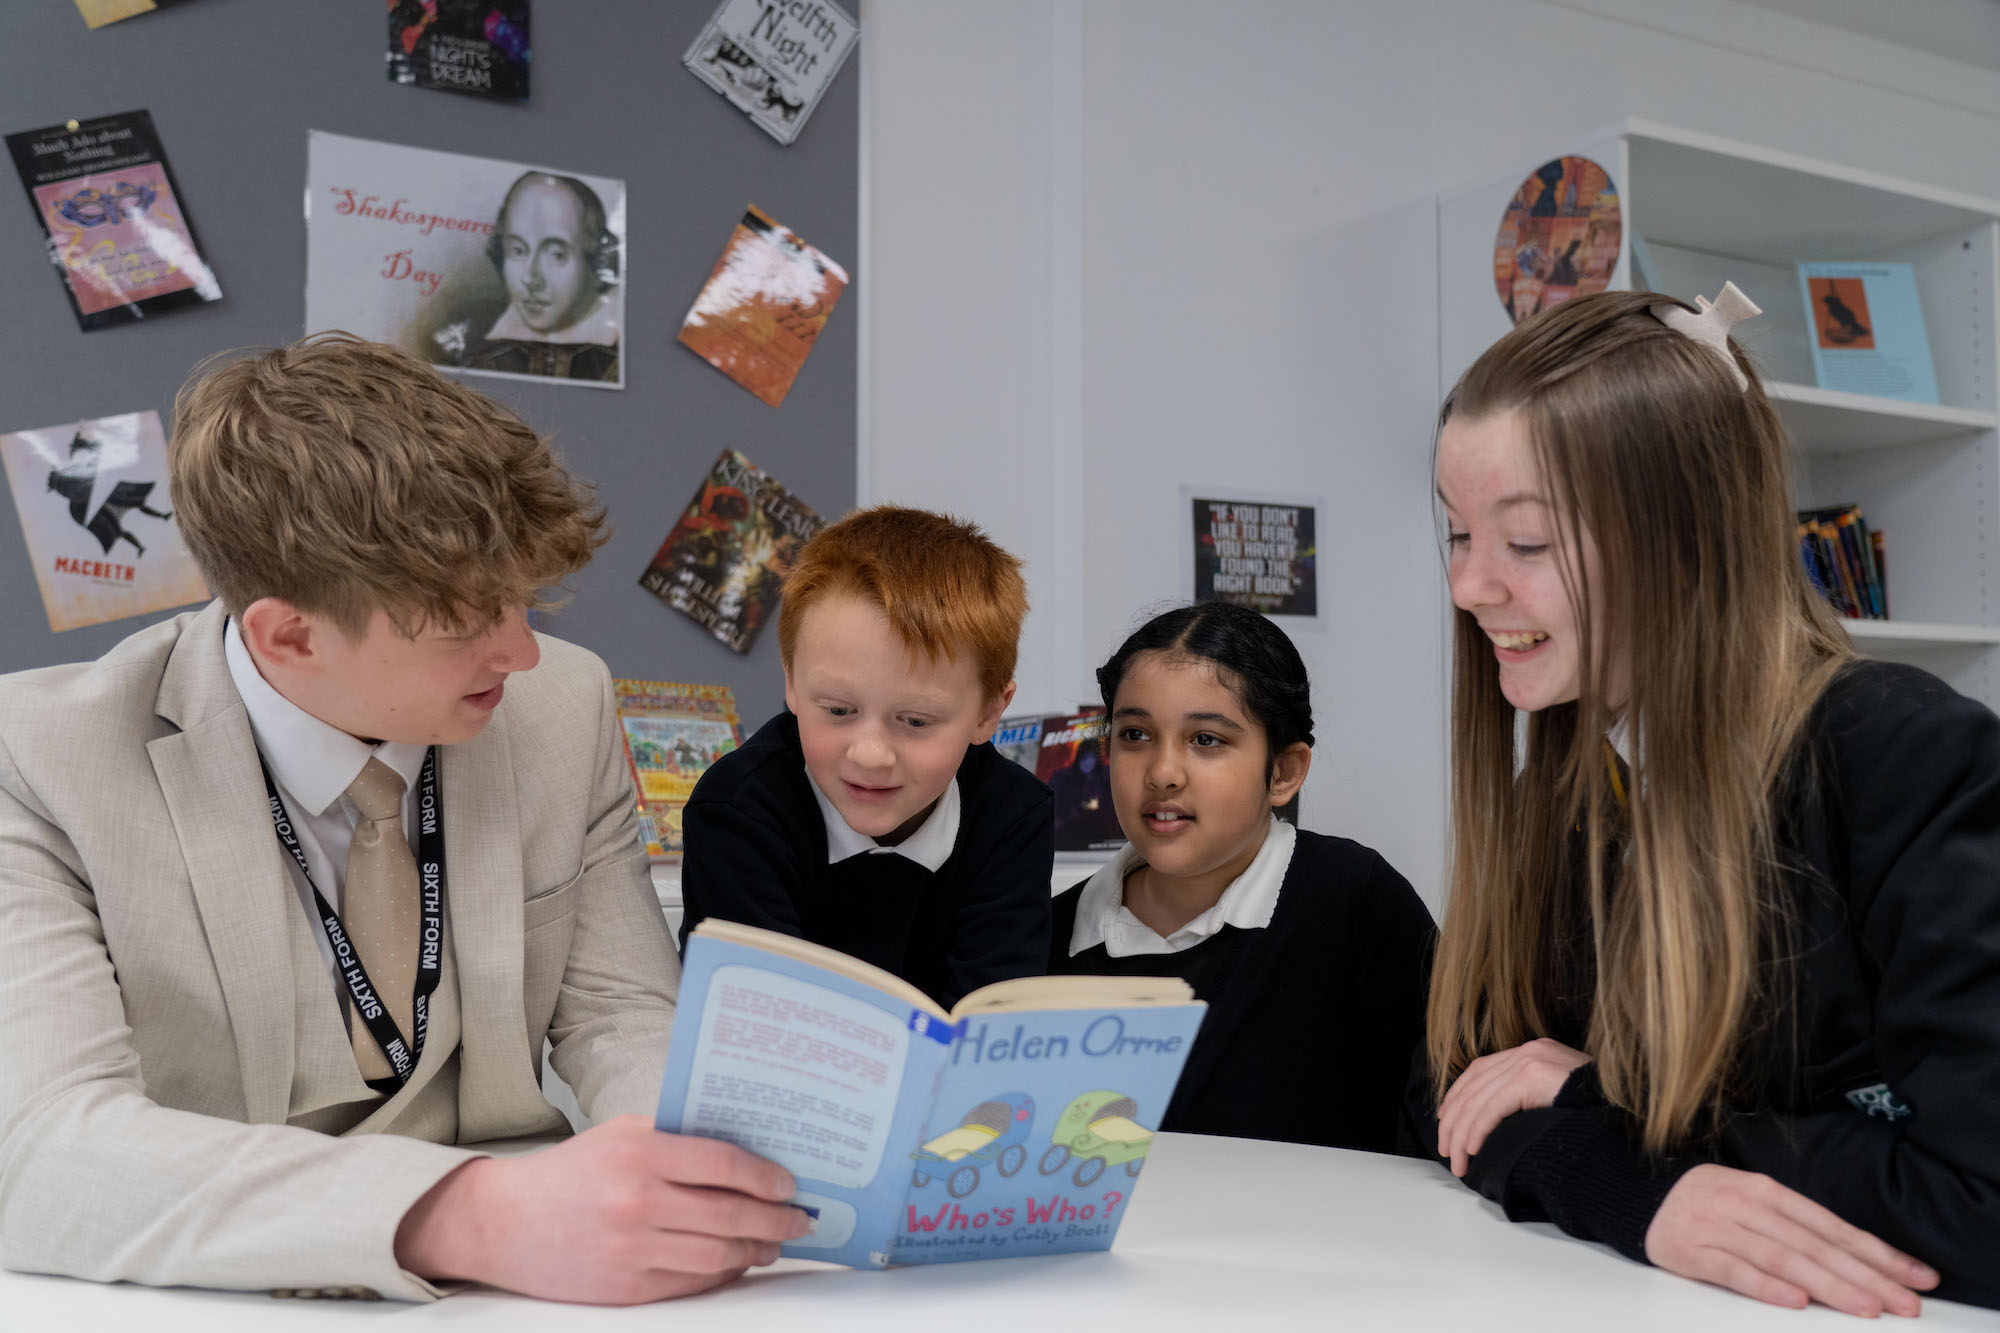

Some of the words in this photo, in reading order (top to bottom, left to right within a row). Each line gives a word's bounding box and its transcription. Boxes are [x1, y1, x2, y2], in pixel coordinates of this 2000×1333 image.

[751, 5, 818, 75] Night
[757, 0, 837, 52] elfth
[430, 62, 492, 88] DREAM
[32, 138, 70, 156] Much
[72, 131, 97, 148] Ado
[98, 127, 134, 143] about
[63, 144, 115, 163] Nothing
[329, 185, 496, 236] Shakespeare
[379, 249, 445, 296] Day
[1211, 522, 1238, 539] LIKE
[1242, 523, 1259, 540] TO
[1230, 504, 1260, 523] YOU
[1261, 506, 1299, 526] DON'T
[54, 556, 136, 581] MACBETH
[1214, 539, 1242, 557] YOU
[1244, 540, 1297, 561] HAVEN'T
[1220, 557, 1265, 576] FOUND
[1267, 559, 1290, 577] THE
[1213, 573, 1251, 593] RIGHT
[423, 746, 435, 783] XTH
[269, 796, 297, 845] FORM
[422, 785, 437, 836] FORM
[423, 862, 440, 913] SIXTH
[324, 916, 356, 969] FORM
[422, 917, 440, 970] FORM
[347, 968, 383, 1020] SIXTH
[386, 1037, 412, 1074] FORM
[951, 1022, 1070, 1066] Helen
[1080, 1014, 1183, 1058] Orme
[907, 1202, 1015, 1233] Who's
[1026, 1191, 1123, 1225] Who?
[894, 1234, 986, 1248] Illustrated
[989, 1233, 1007, 1247] by
[1012, 1227, 1060, 1245] Cathy
